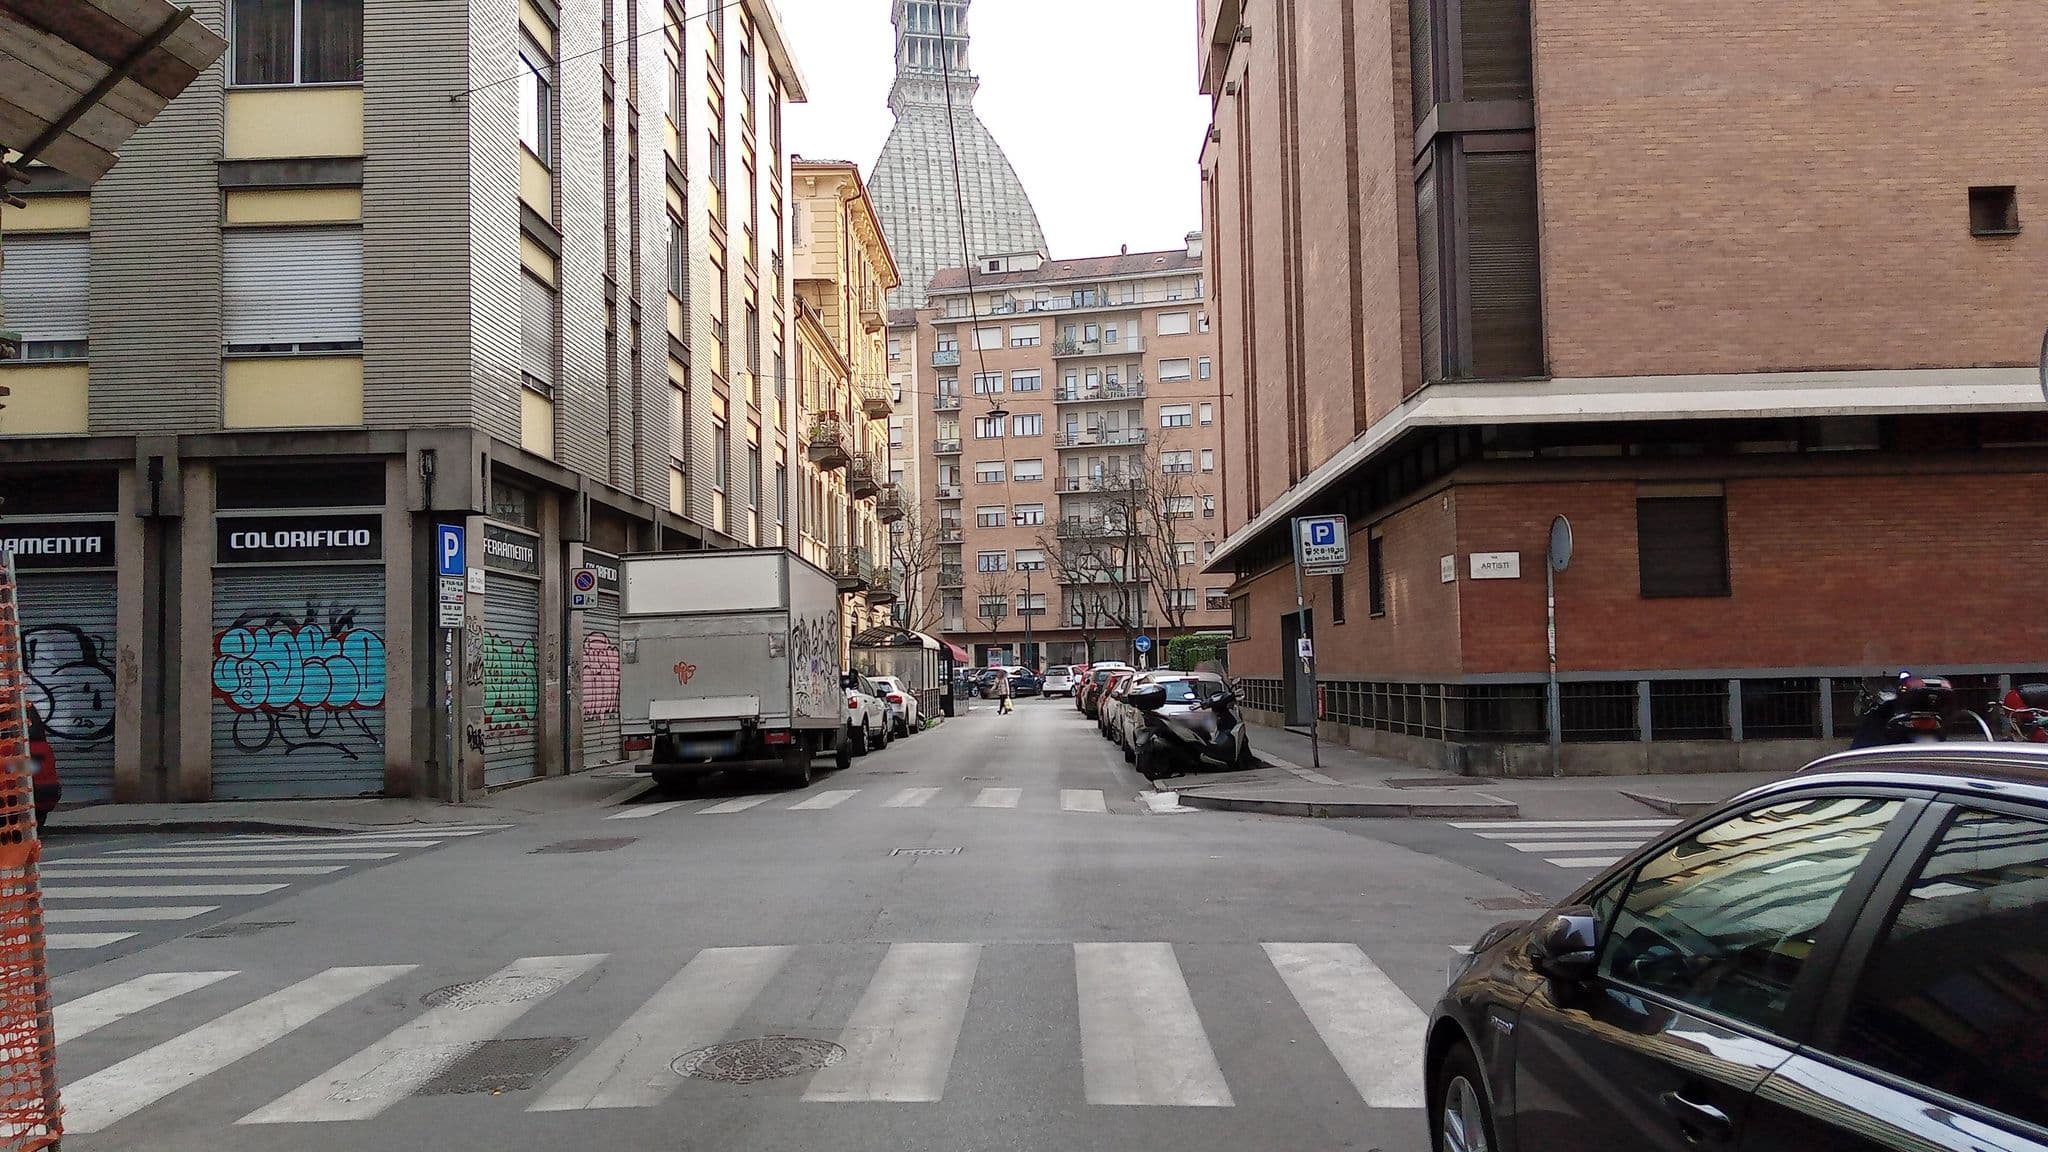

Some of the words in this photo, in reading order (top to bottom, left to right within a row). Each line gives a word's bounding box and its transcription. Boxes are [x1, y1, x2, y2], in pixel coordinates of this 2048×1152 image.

[230, 528, 370, 549] COLORIFICIO
[1316, 526, 1329, 543] P
[0, 536, 101, 554] AMENTA
[443, 532, 459, 569] P
[483, 538, 533, 563] FERRAMENTA
[575, 595, 583, 604] P
